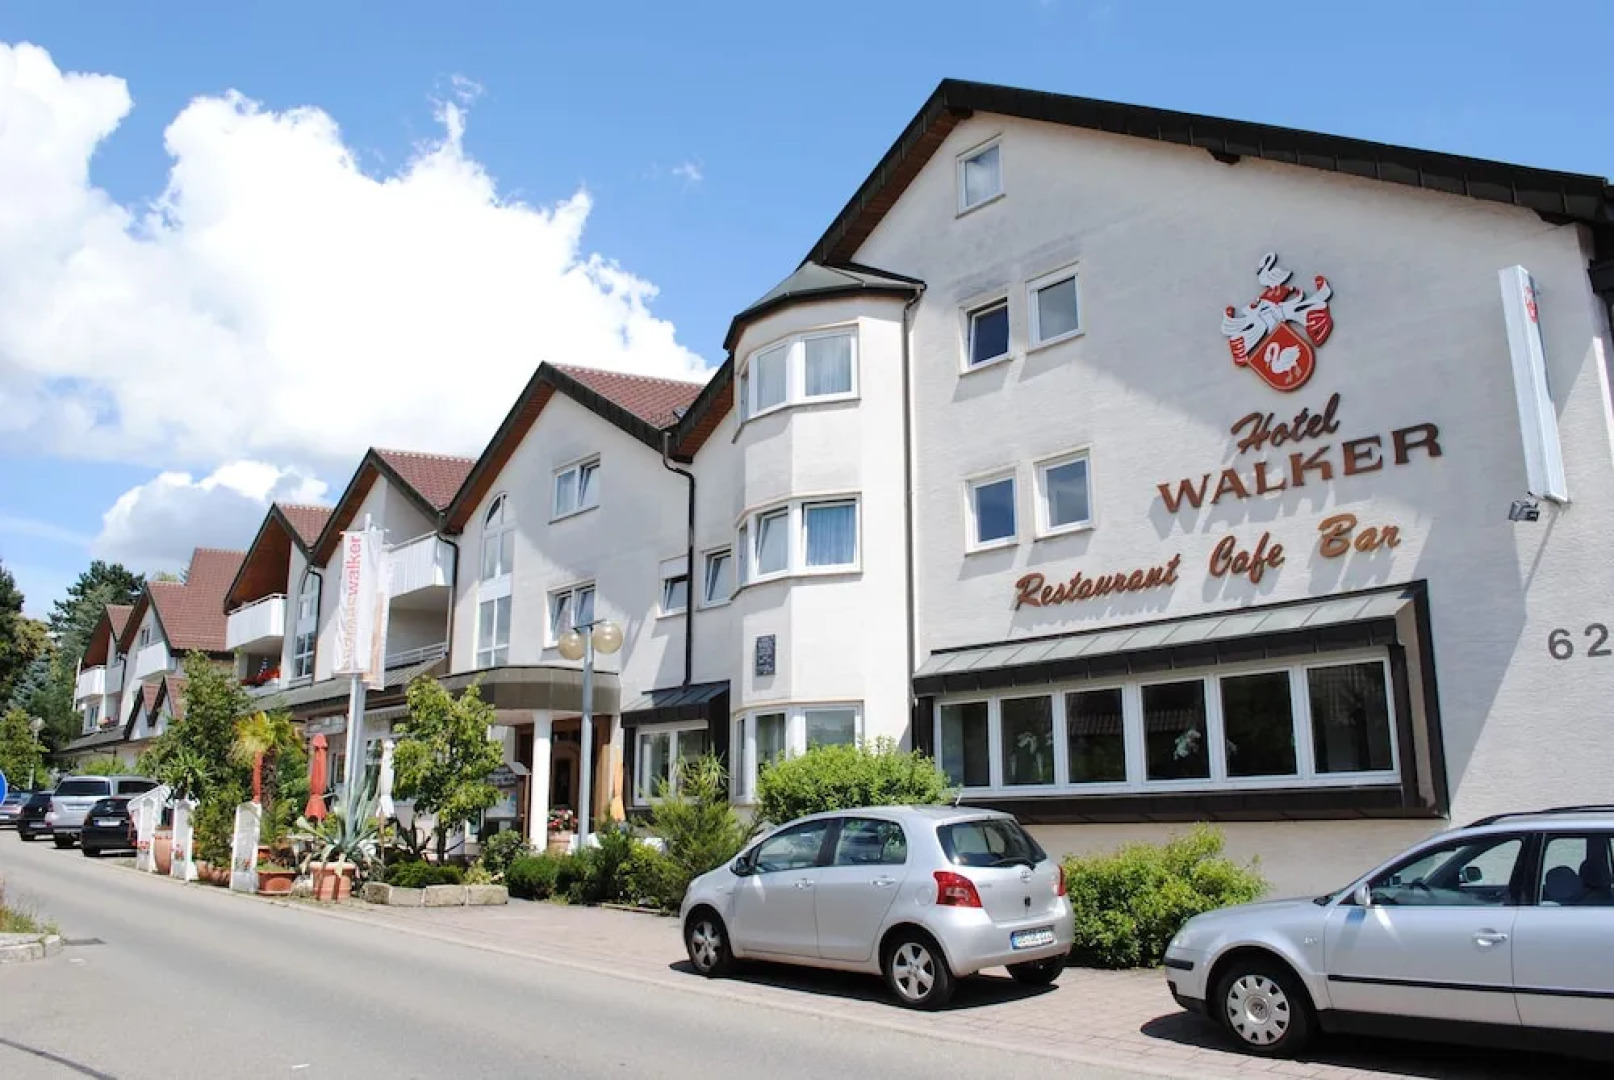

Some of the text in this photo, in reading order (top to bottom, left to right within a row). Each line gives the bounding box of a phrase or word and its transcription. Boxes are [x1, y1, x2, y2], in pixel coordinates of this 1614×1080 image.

[1230, 392, 1341, 455] Hotel
[1157, 422, 1443, 514] WALKER
[1014, 512, 1402, 611] Restaurant Cafe Bar
[1548, 622, 1612, 660] 62
